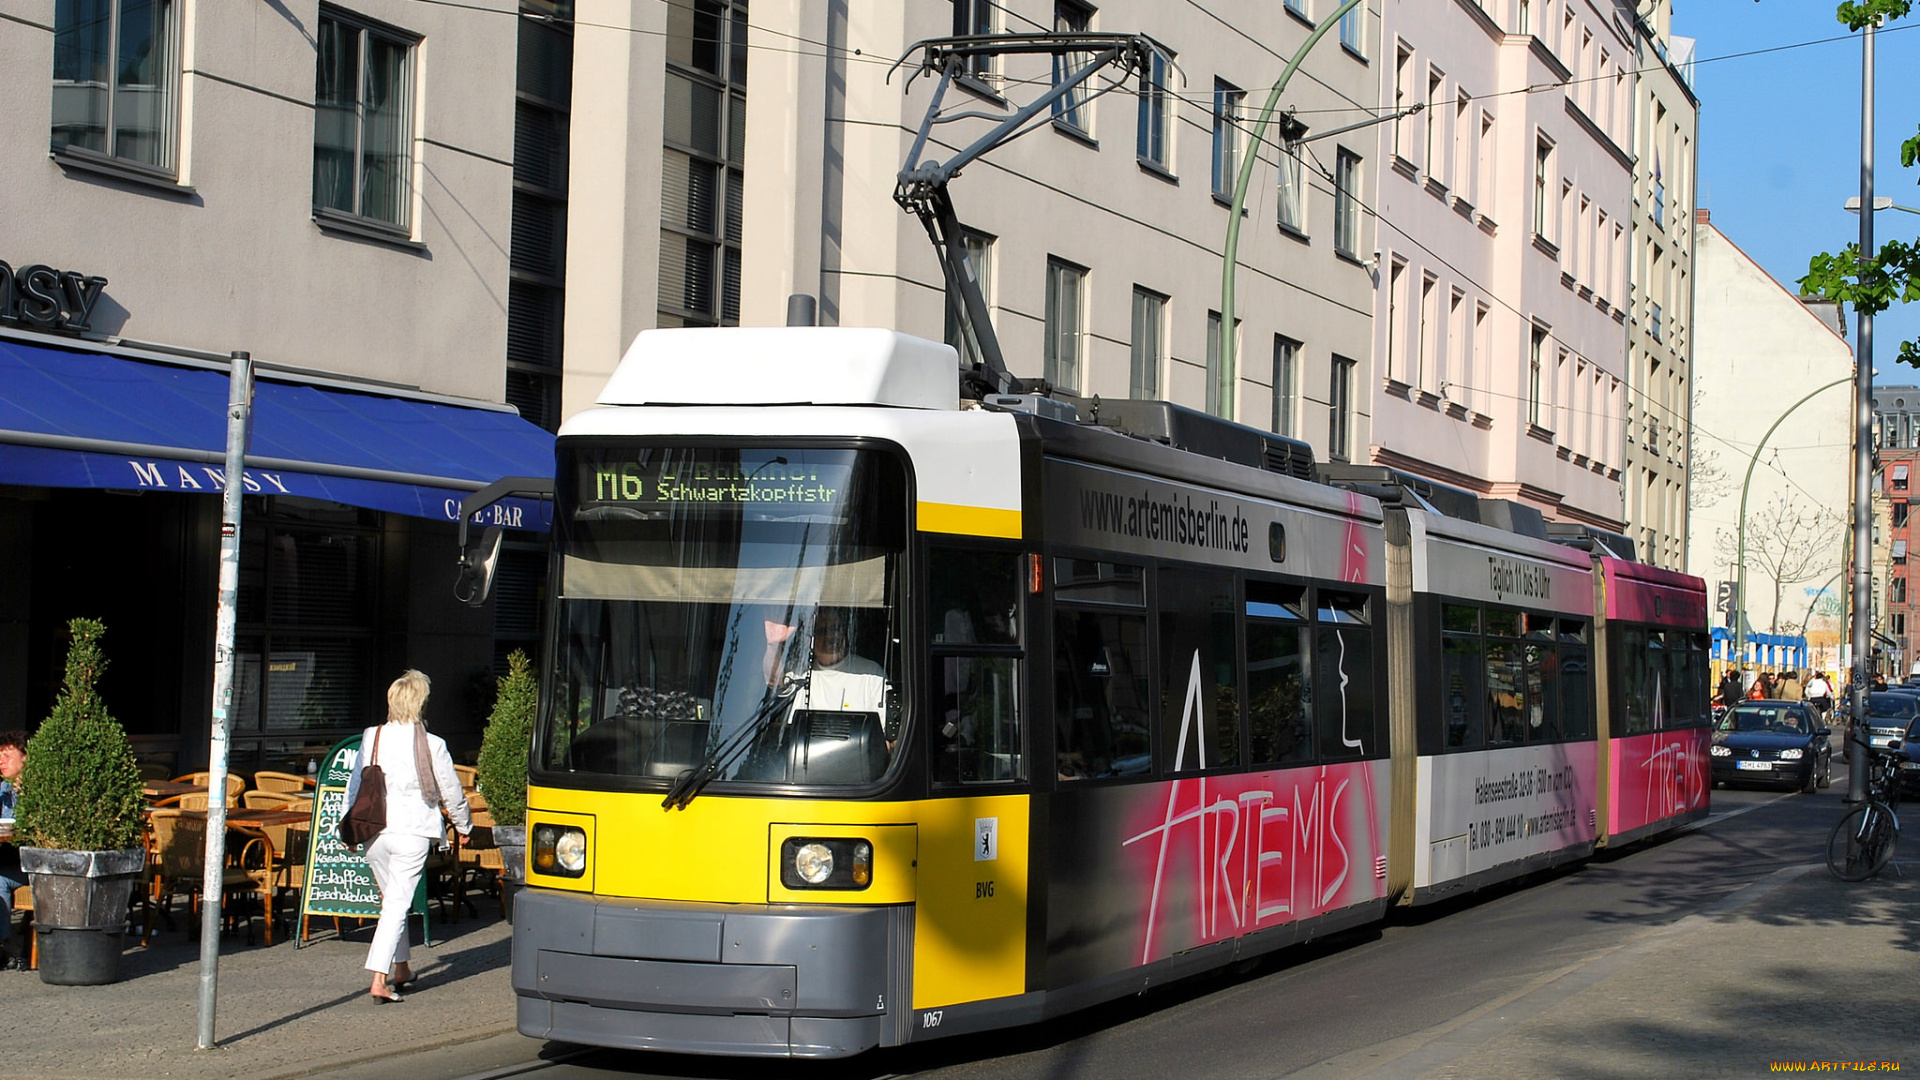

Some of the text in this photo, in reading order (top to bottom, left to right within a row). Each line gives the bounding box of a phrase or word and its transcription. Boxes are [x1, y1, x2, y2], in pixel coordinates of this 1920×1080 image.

[128, 461, 291, 493] MANSY
[596, 465, 643, 501] M6
[657, 482, 837, 503] Schwartzkopffstr
[444, 499, 522, 527] CAE BAR
[1079, 487, 1249, 554] www.artemisberlin.de
[1488, 556, 1550, 601] Täglich 11 bis 5 Uhr
[1122, 648, 1349, 965] ARTEMIS
[976, 881, 994, 898] BVG
[923, 1011, 943, 1028] 1067
